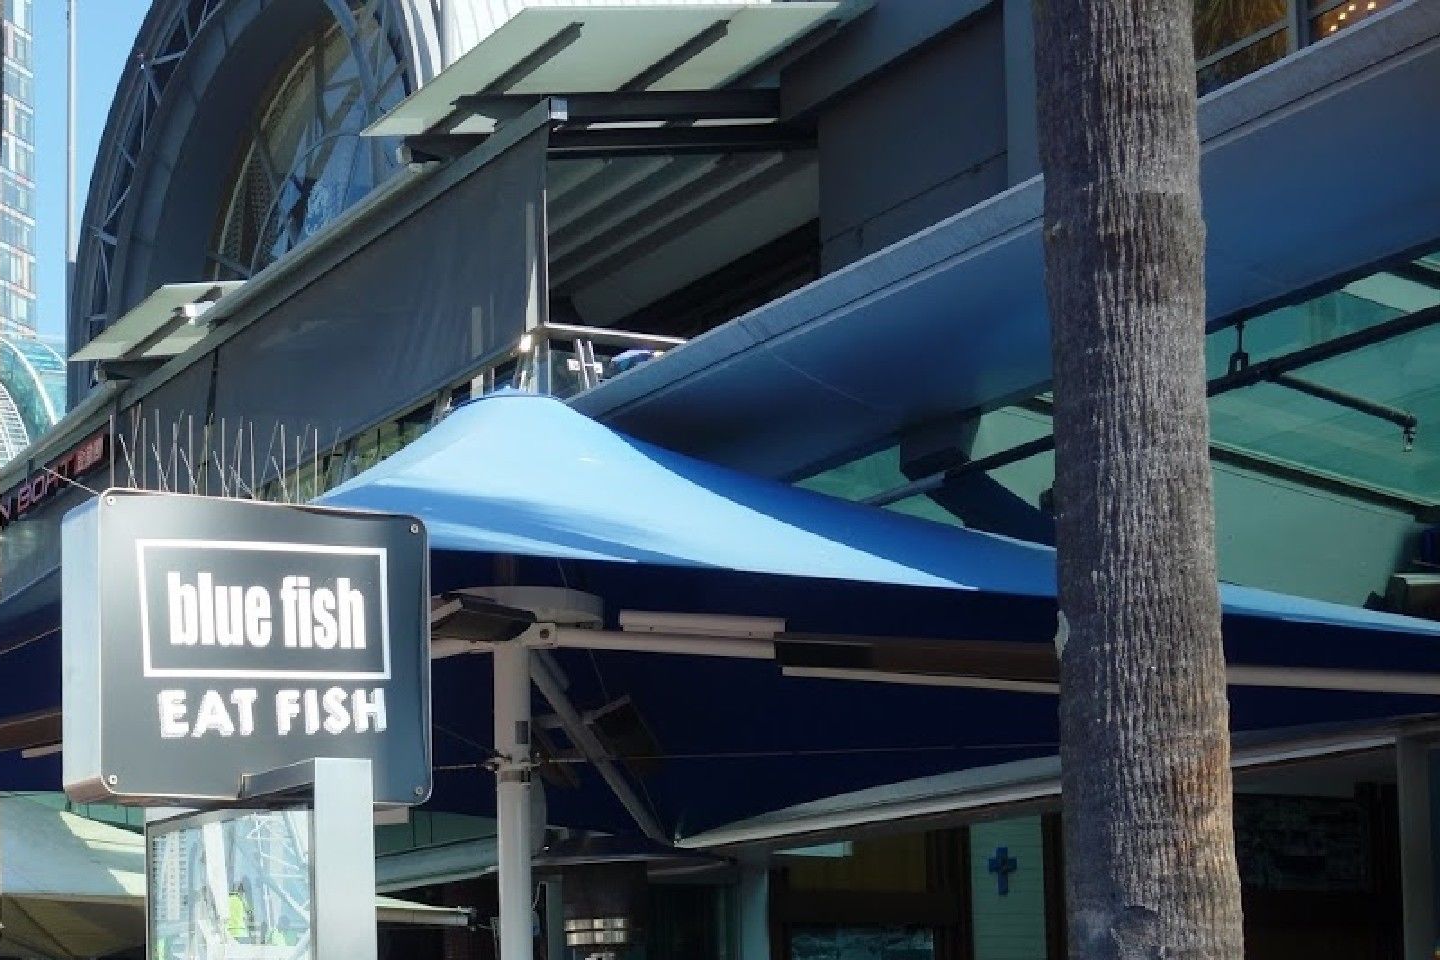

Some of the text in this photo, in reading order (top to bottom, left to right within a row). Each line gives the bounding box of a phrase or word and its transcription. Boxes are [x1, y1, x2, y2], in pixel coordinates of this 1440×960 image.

[167, 571, 366, 650] blue fish
[158, 686, 388, 738] EAT FISH
